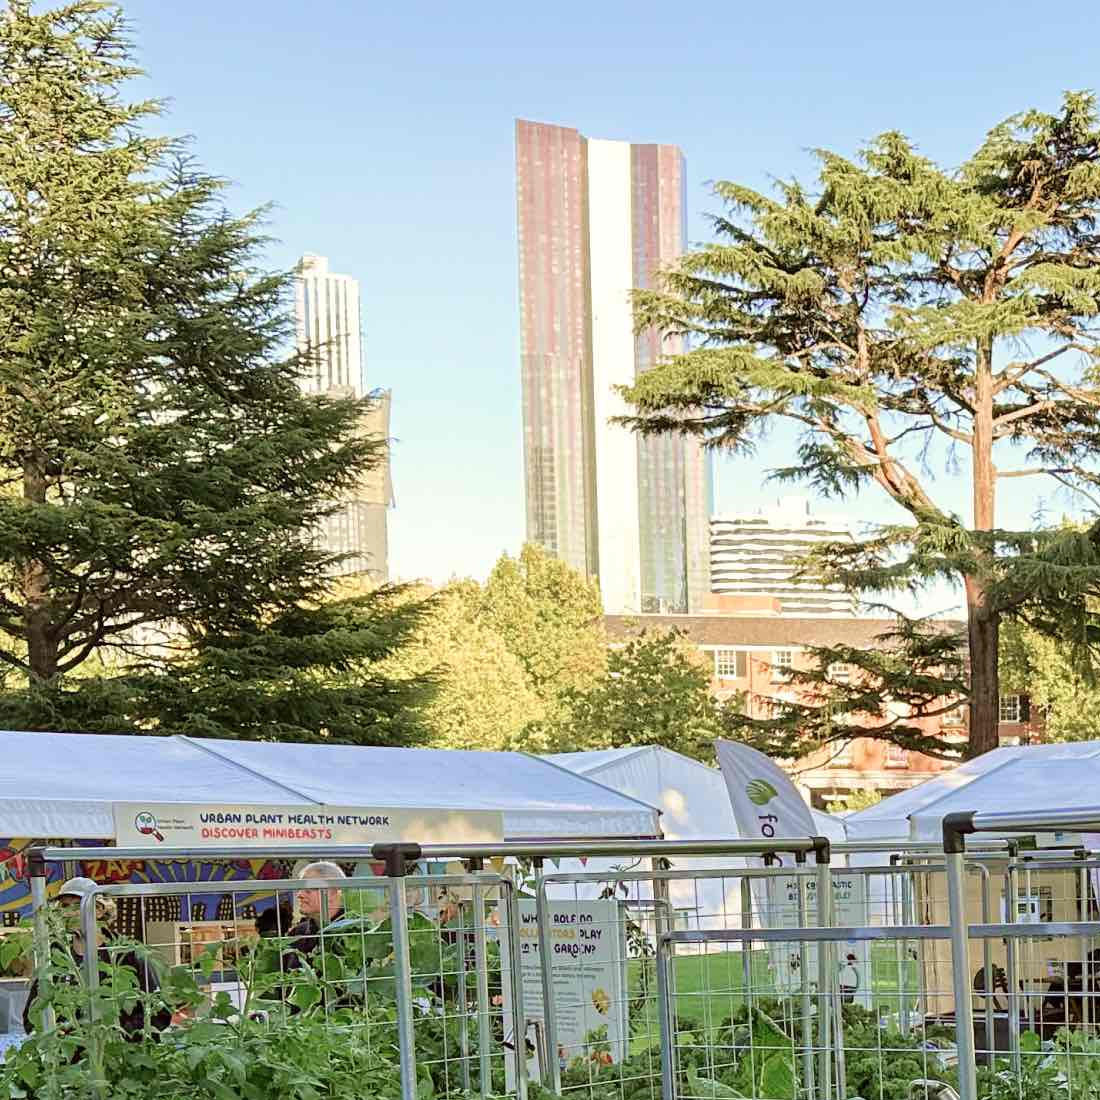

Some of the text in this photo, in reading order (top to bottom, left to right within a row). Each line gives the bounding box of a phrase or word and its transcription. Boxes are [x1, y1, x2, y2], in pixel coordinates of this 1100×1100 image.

[200, 813, 389, 826] URBAN PLANT HEALTH NETWORK
[202, 828, 332, 839] DISCOVER MINIBEASTS
